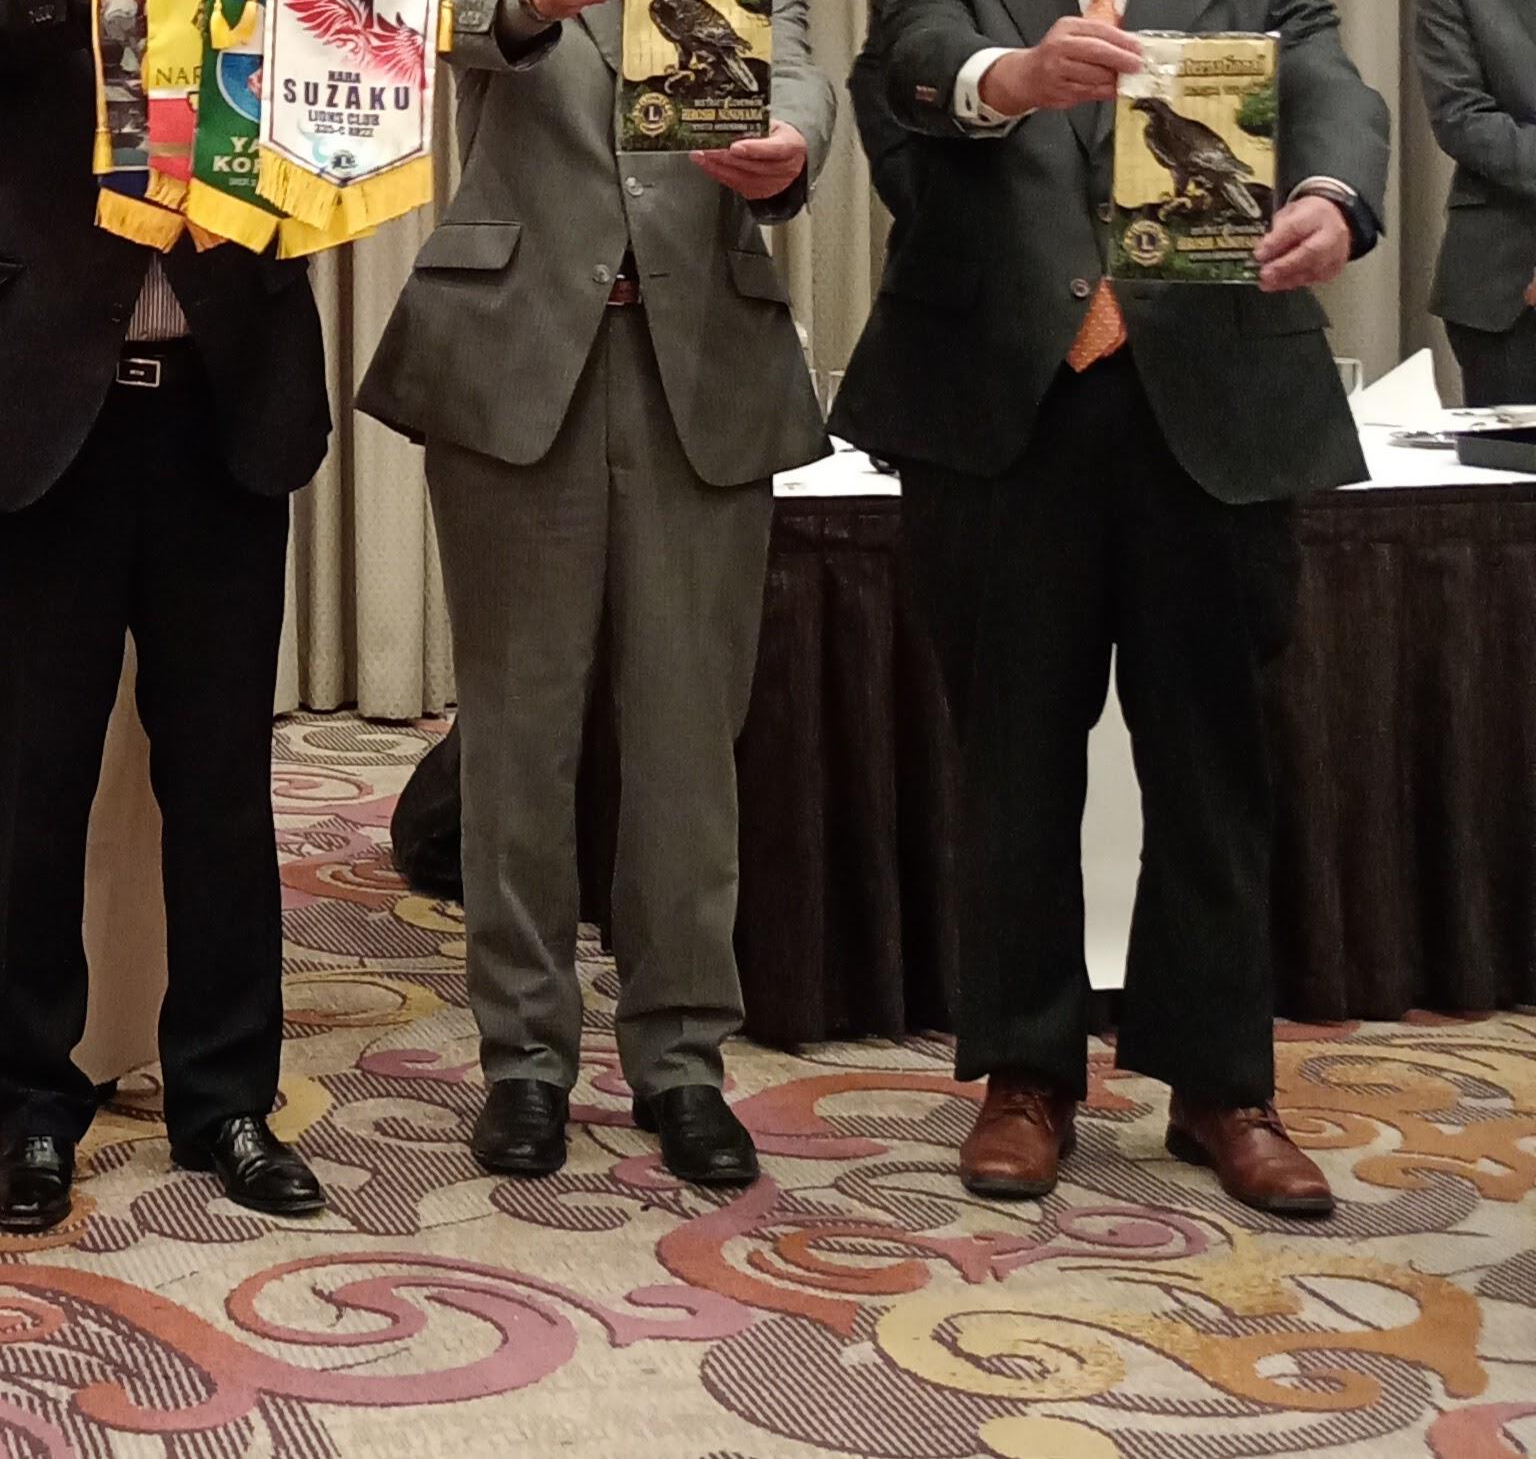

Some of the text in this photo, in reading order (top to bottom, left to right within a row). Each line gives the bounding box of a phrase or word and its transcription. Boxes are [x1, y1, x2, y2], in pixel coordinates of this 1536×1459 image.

[328, 71, 360, 83] NARA
[283, 78, 409, 110] SUZAKU
[308, 109, 380, 126] LIONS CLUB
